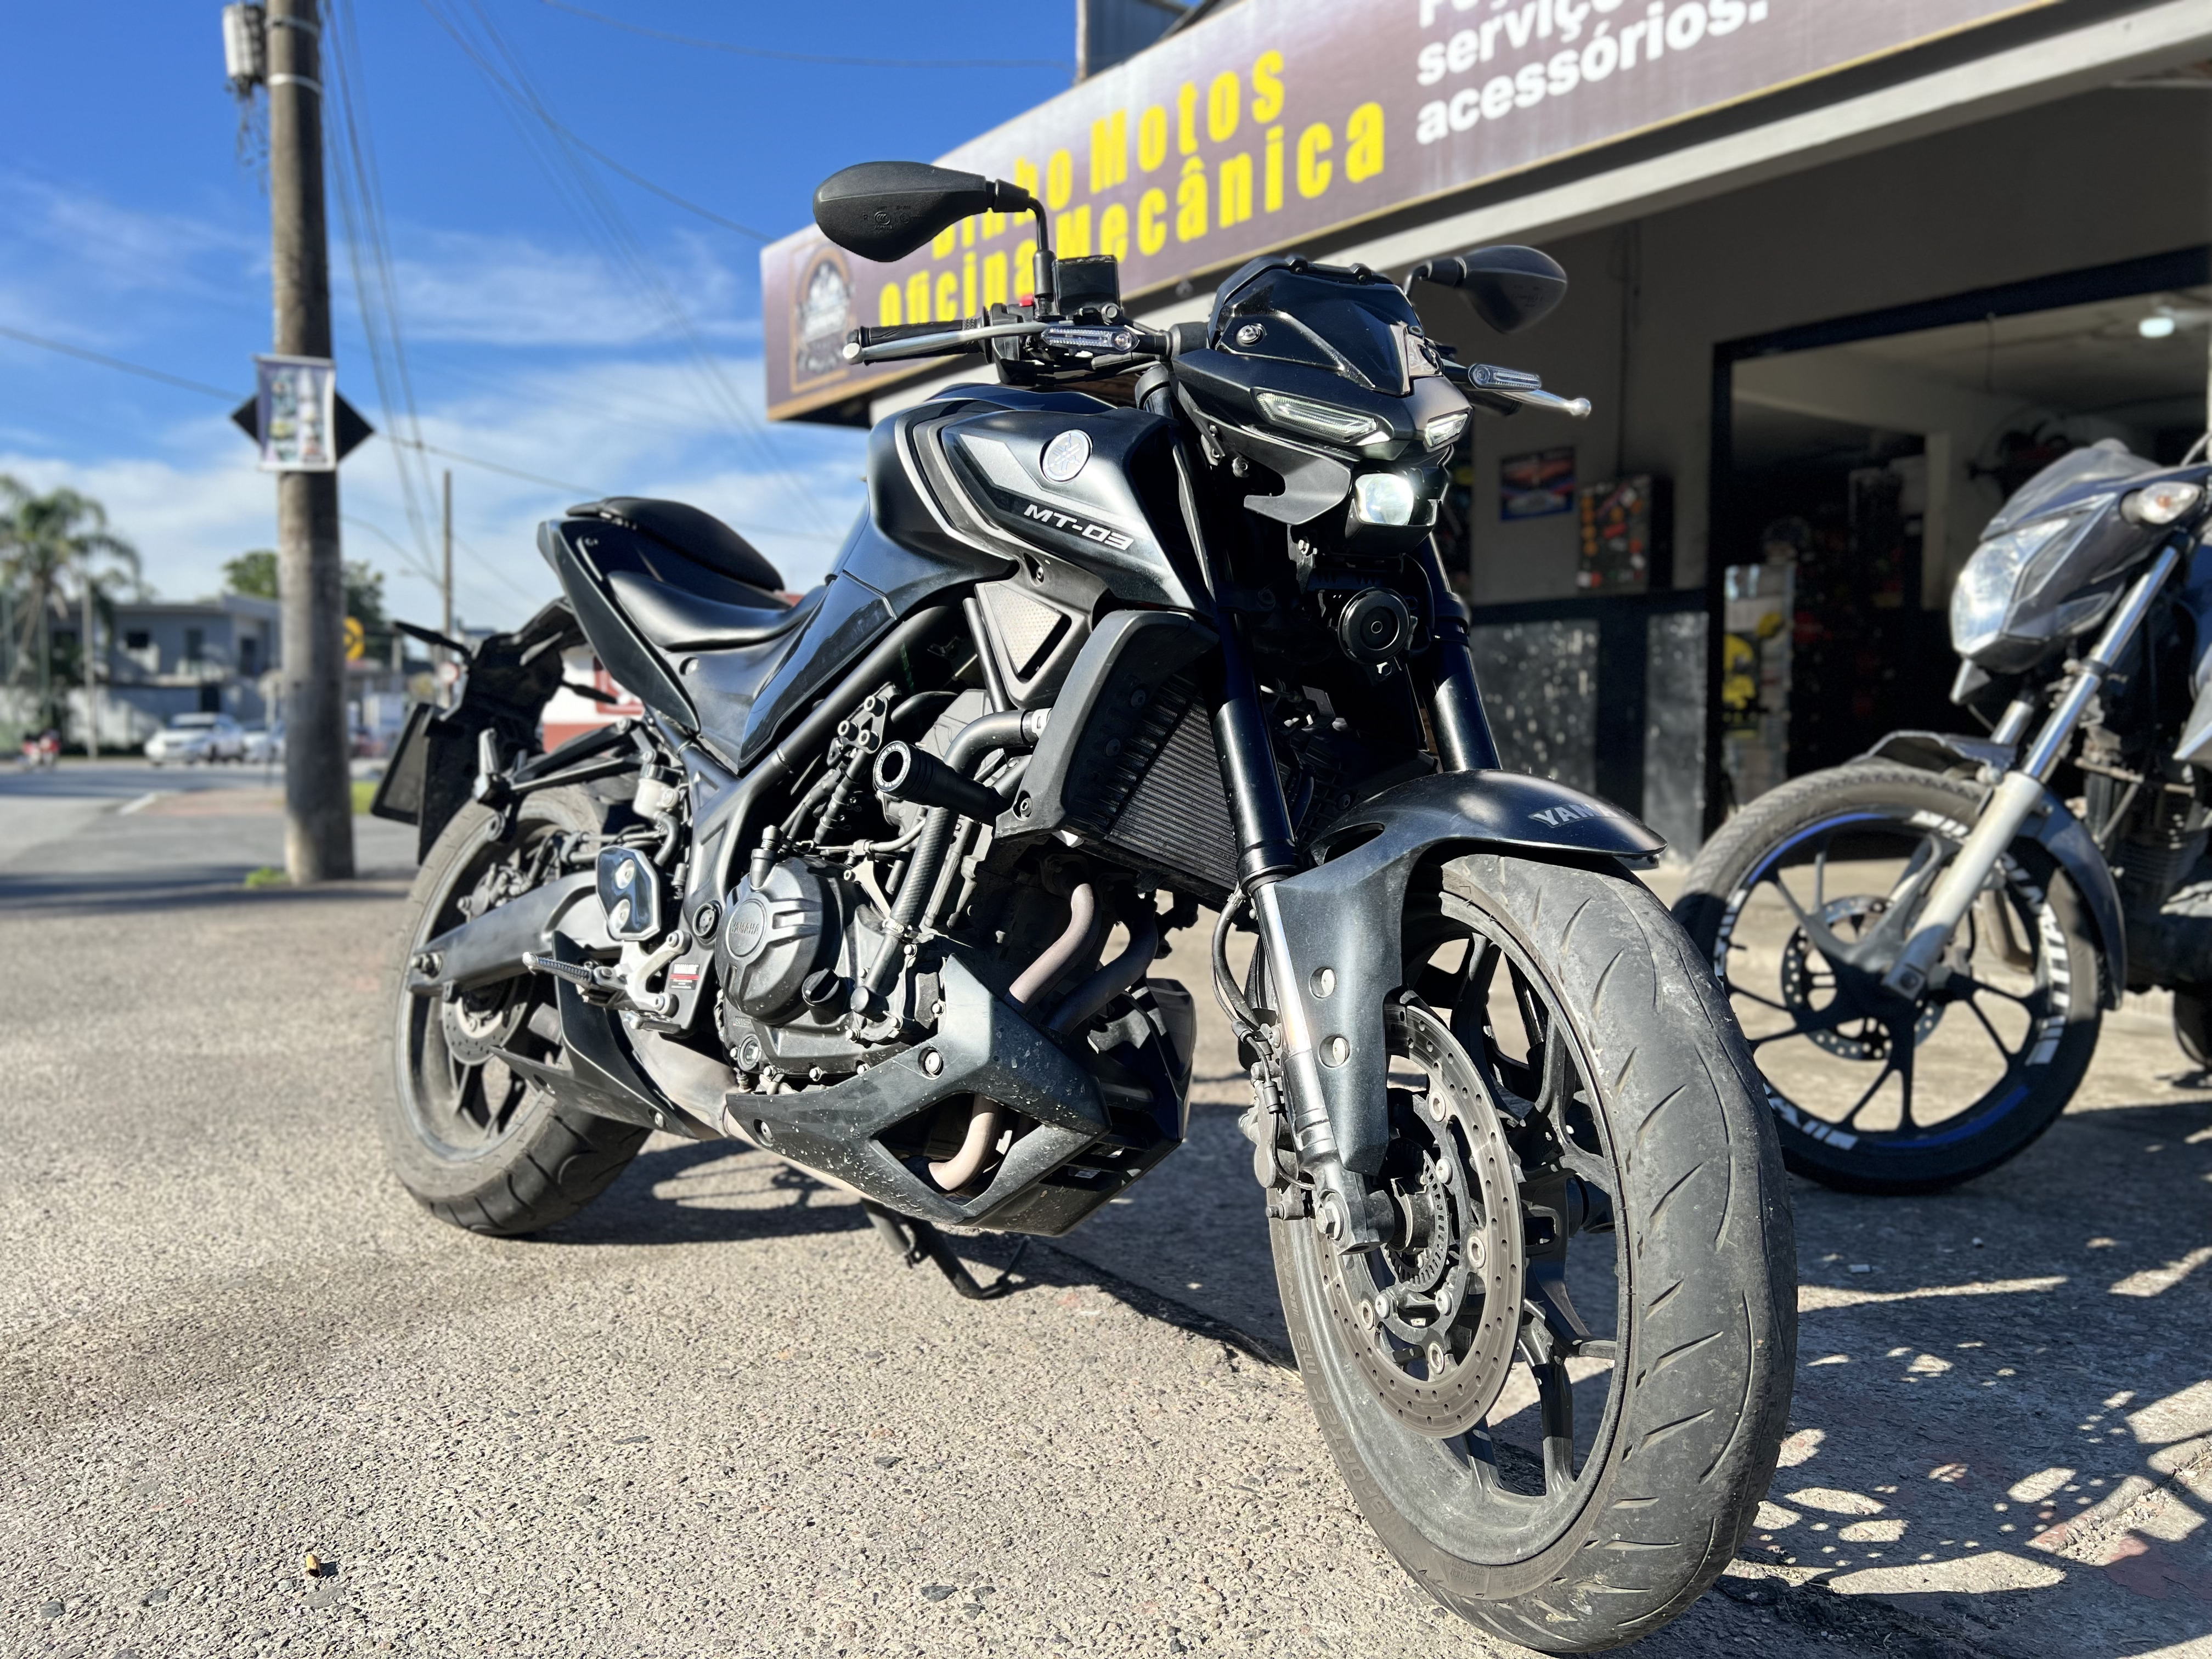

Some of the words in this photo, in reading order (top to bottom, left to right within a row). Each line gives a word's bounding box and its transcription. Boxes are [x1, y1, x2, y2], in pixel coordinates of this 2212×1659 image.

[1090, 49, 1285, 194] Motos
[1417, 0, 1769, 144] acessórios.
[1056, 101, 1385, 263] Mecânica
[1024, 504, 1135, 551] MT-03
[731, 922, 759, 935] YAMAHA
